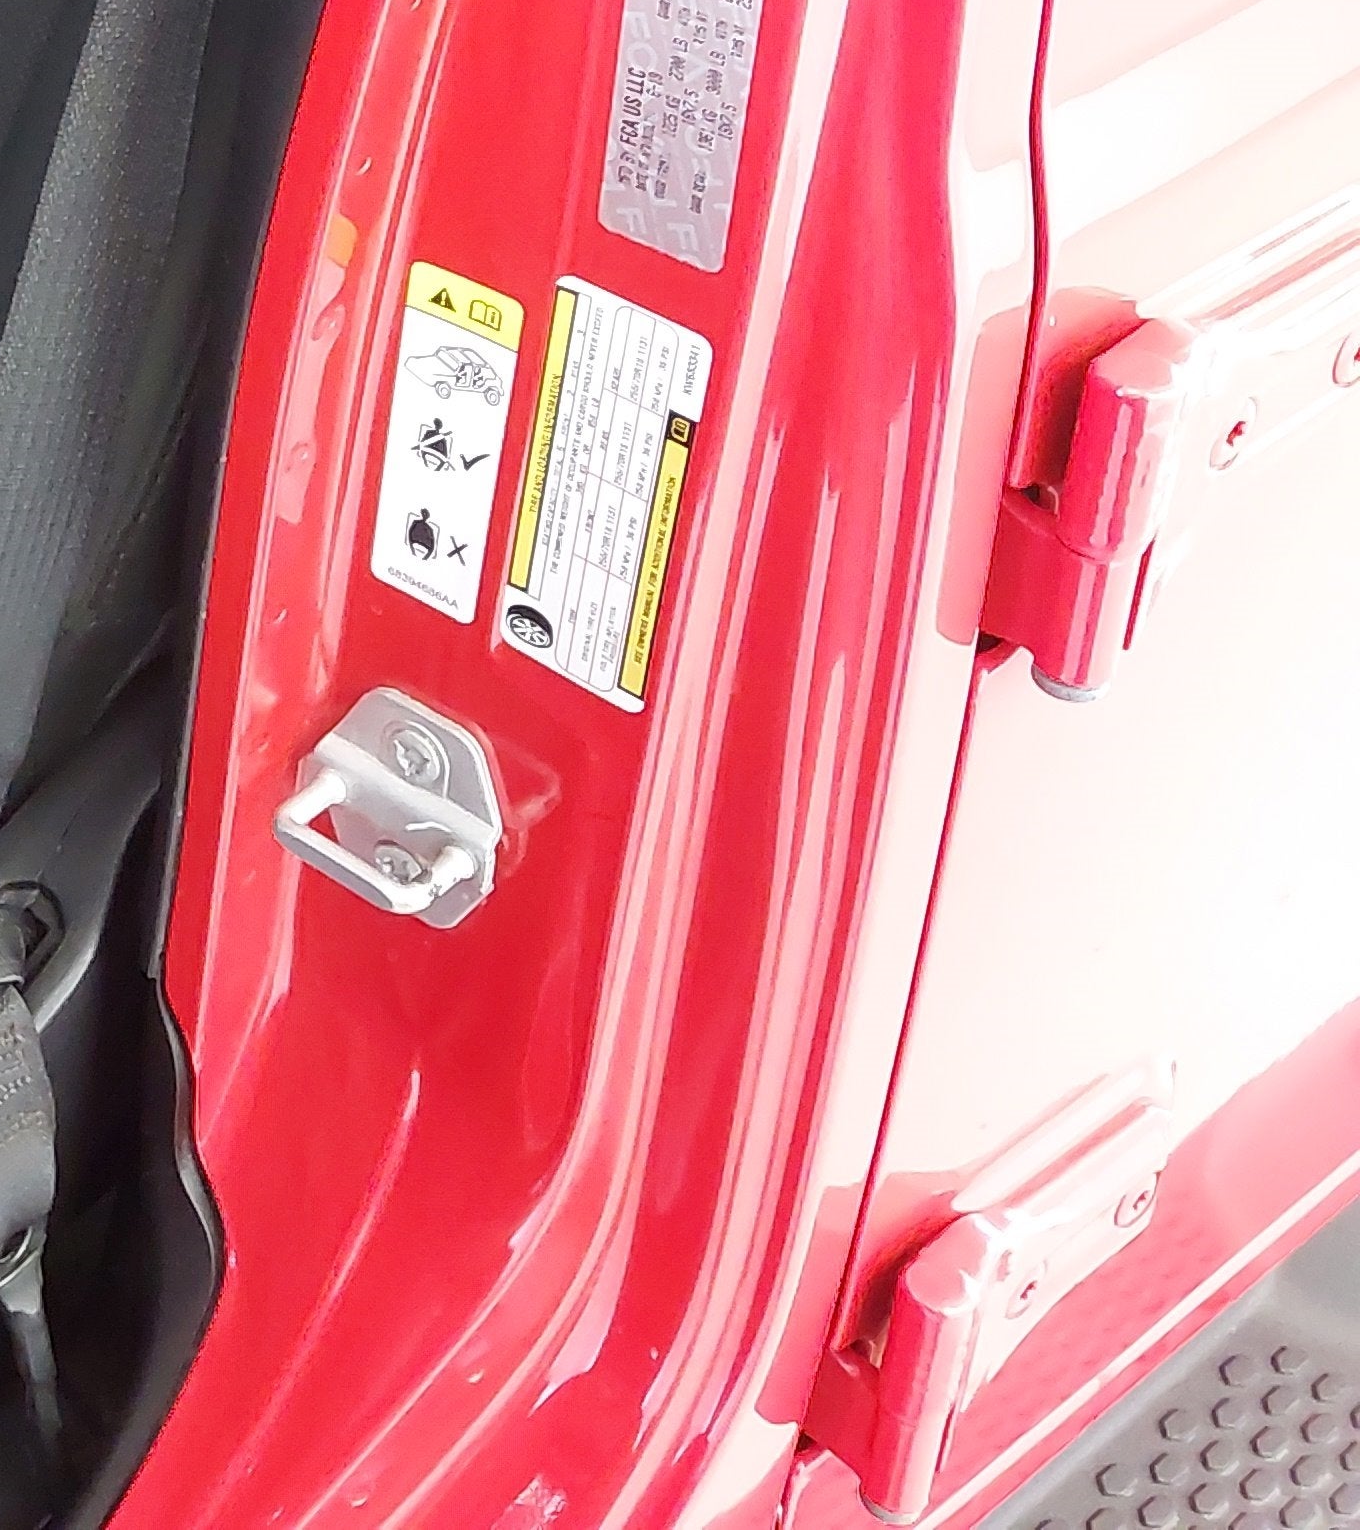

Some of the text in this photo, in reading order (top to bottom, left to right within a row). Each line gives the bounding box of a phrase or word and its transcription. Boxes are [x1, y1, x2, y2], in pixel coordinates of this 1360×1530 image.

[625, 64, 646, 96] LLC
[622, 94, 642, 118] US
[619, 116, 639, 147] FCA
